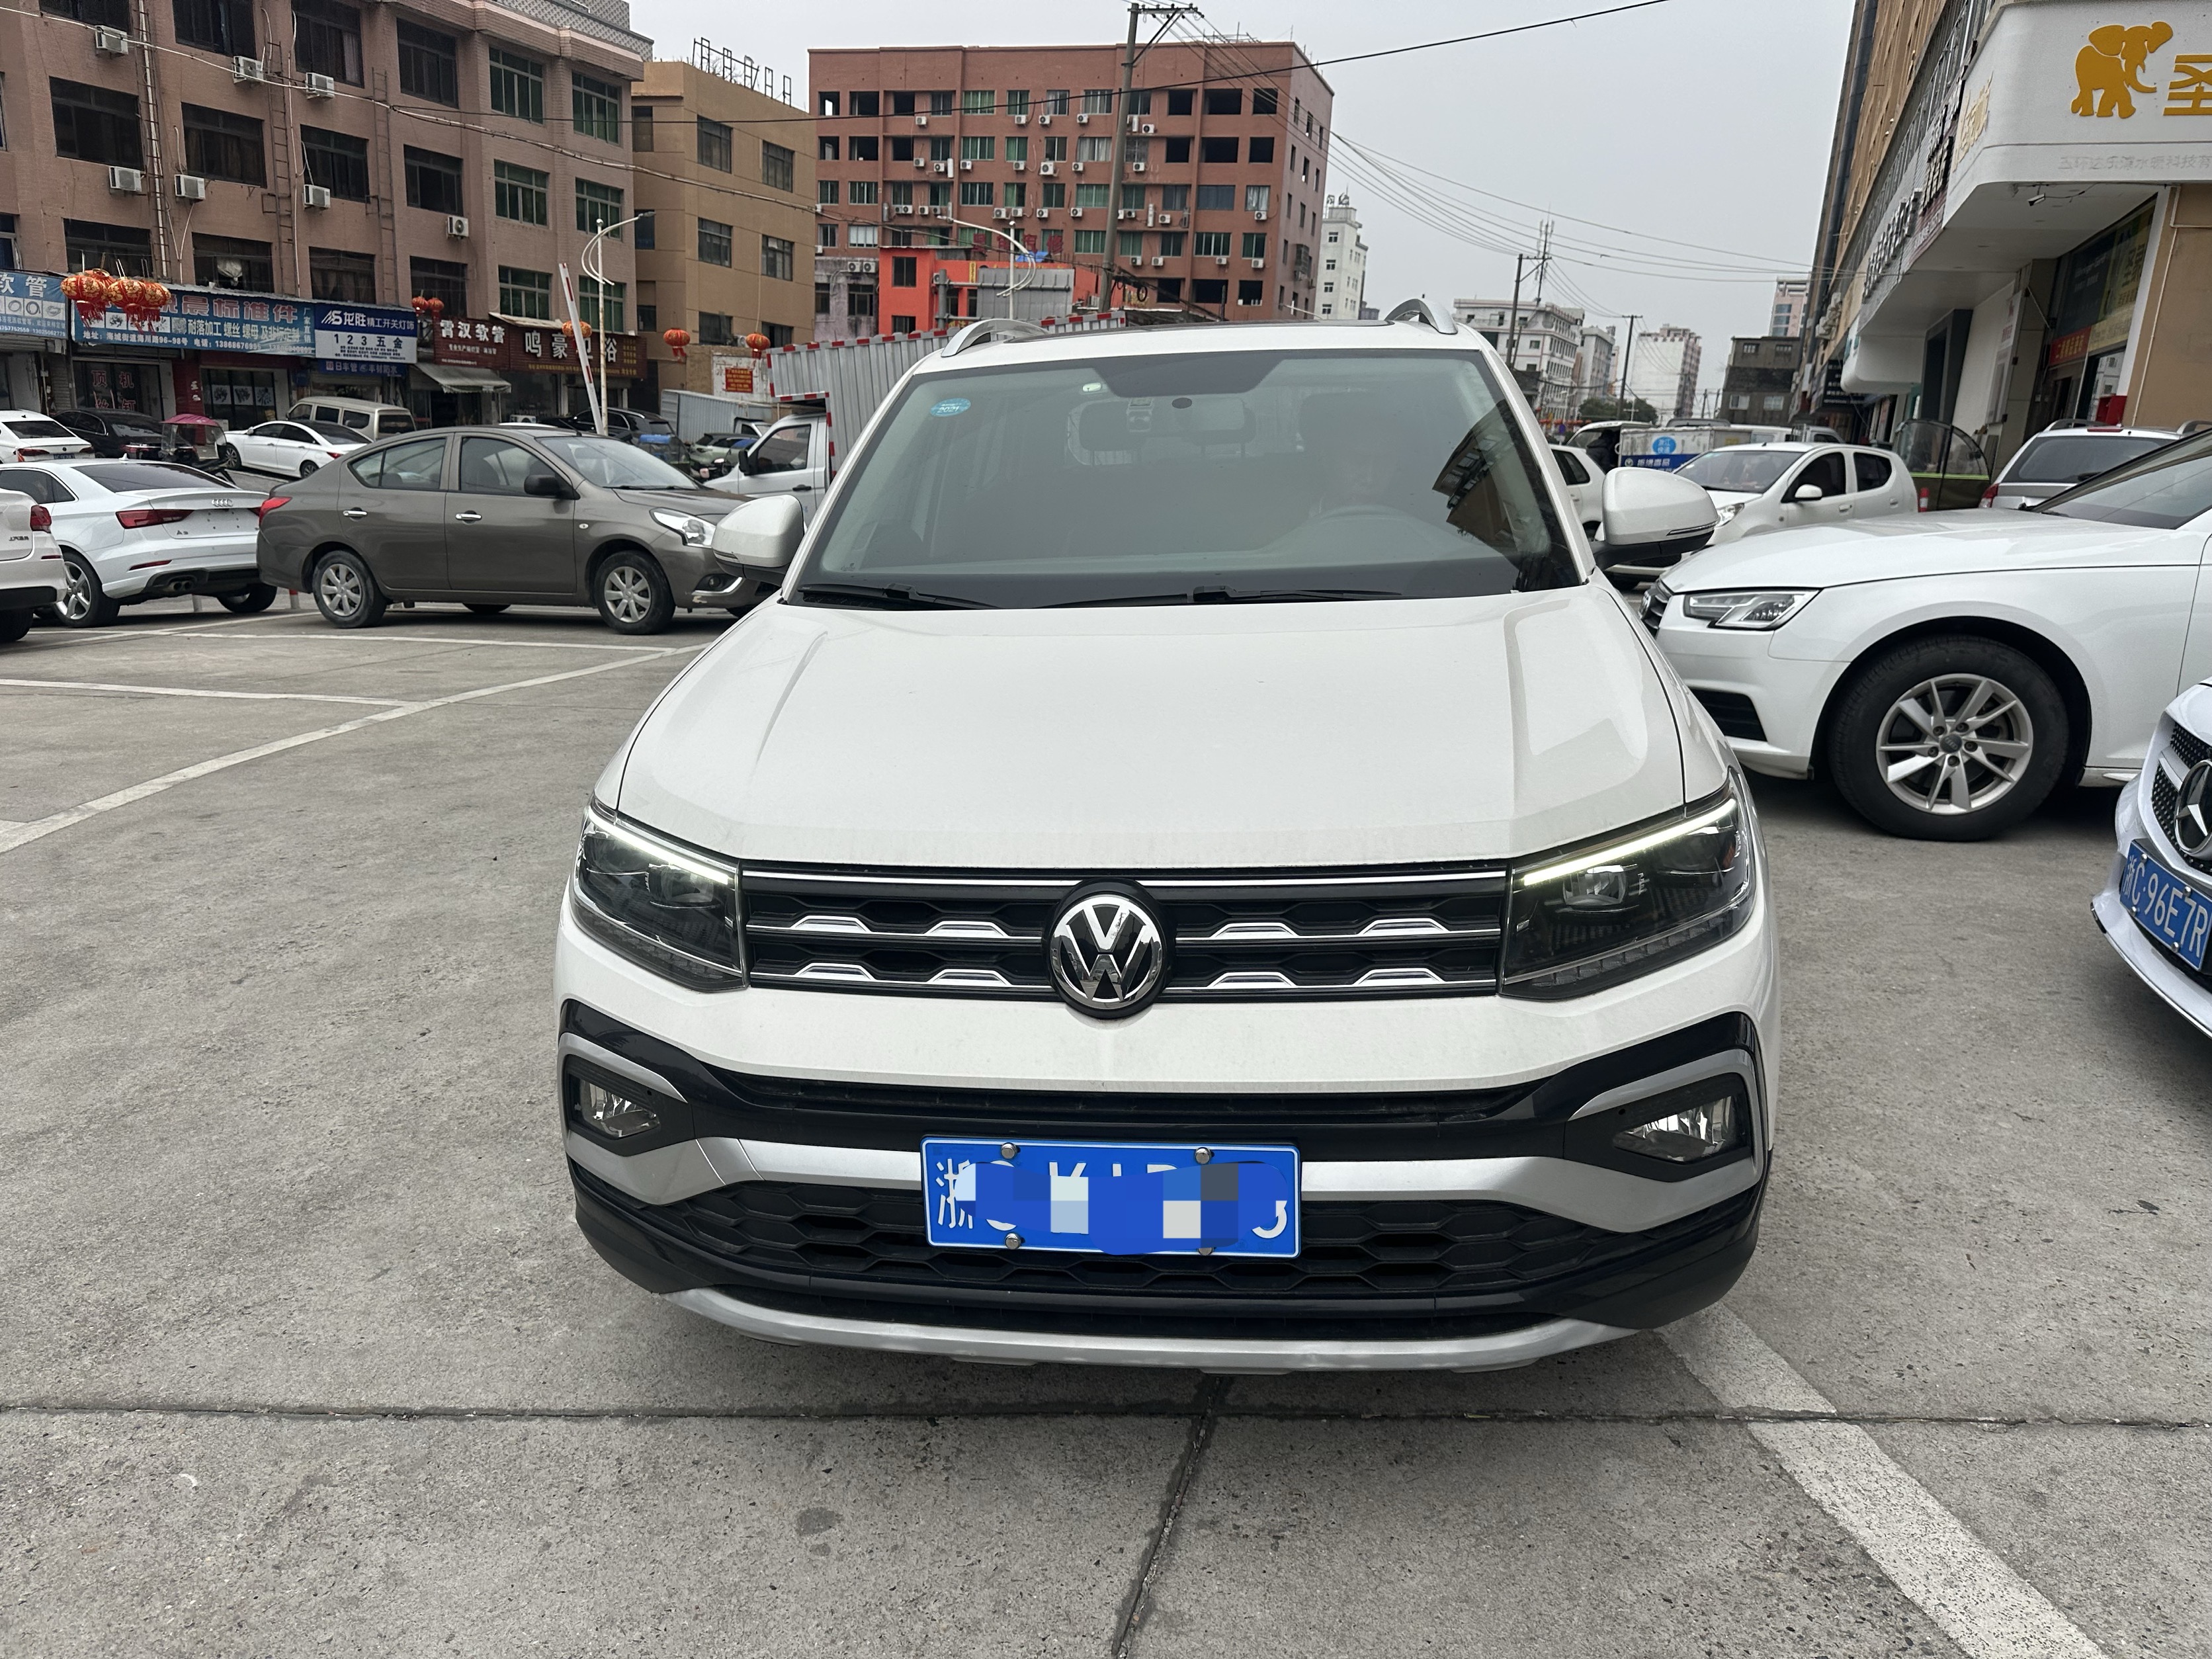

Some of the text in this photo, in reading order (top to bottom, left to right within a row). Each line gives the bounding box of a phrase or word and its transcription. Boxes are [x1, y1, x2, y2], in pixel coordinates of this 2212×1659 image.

[2163, 54, 2212, 116] 圣
[0, 273, 47, 298] 软管
[188, 319, 222, 337] 耐落加工
[224, 321, 240, 338] 螺丝
[242, 323, 259, 340] 螺母
